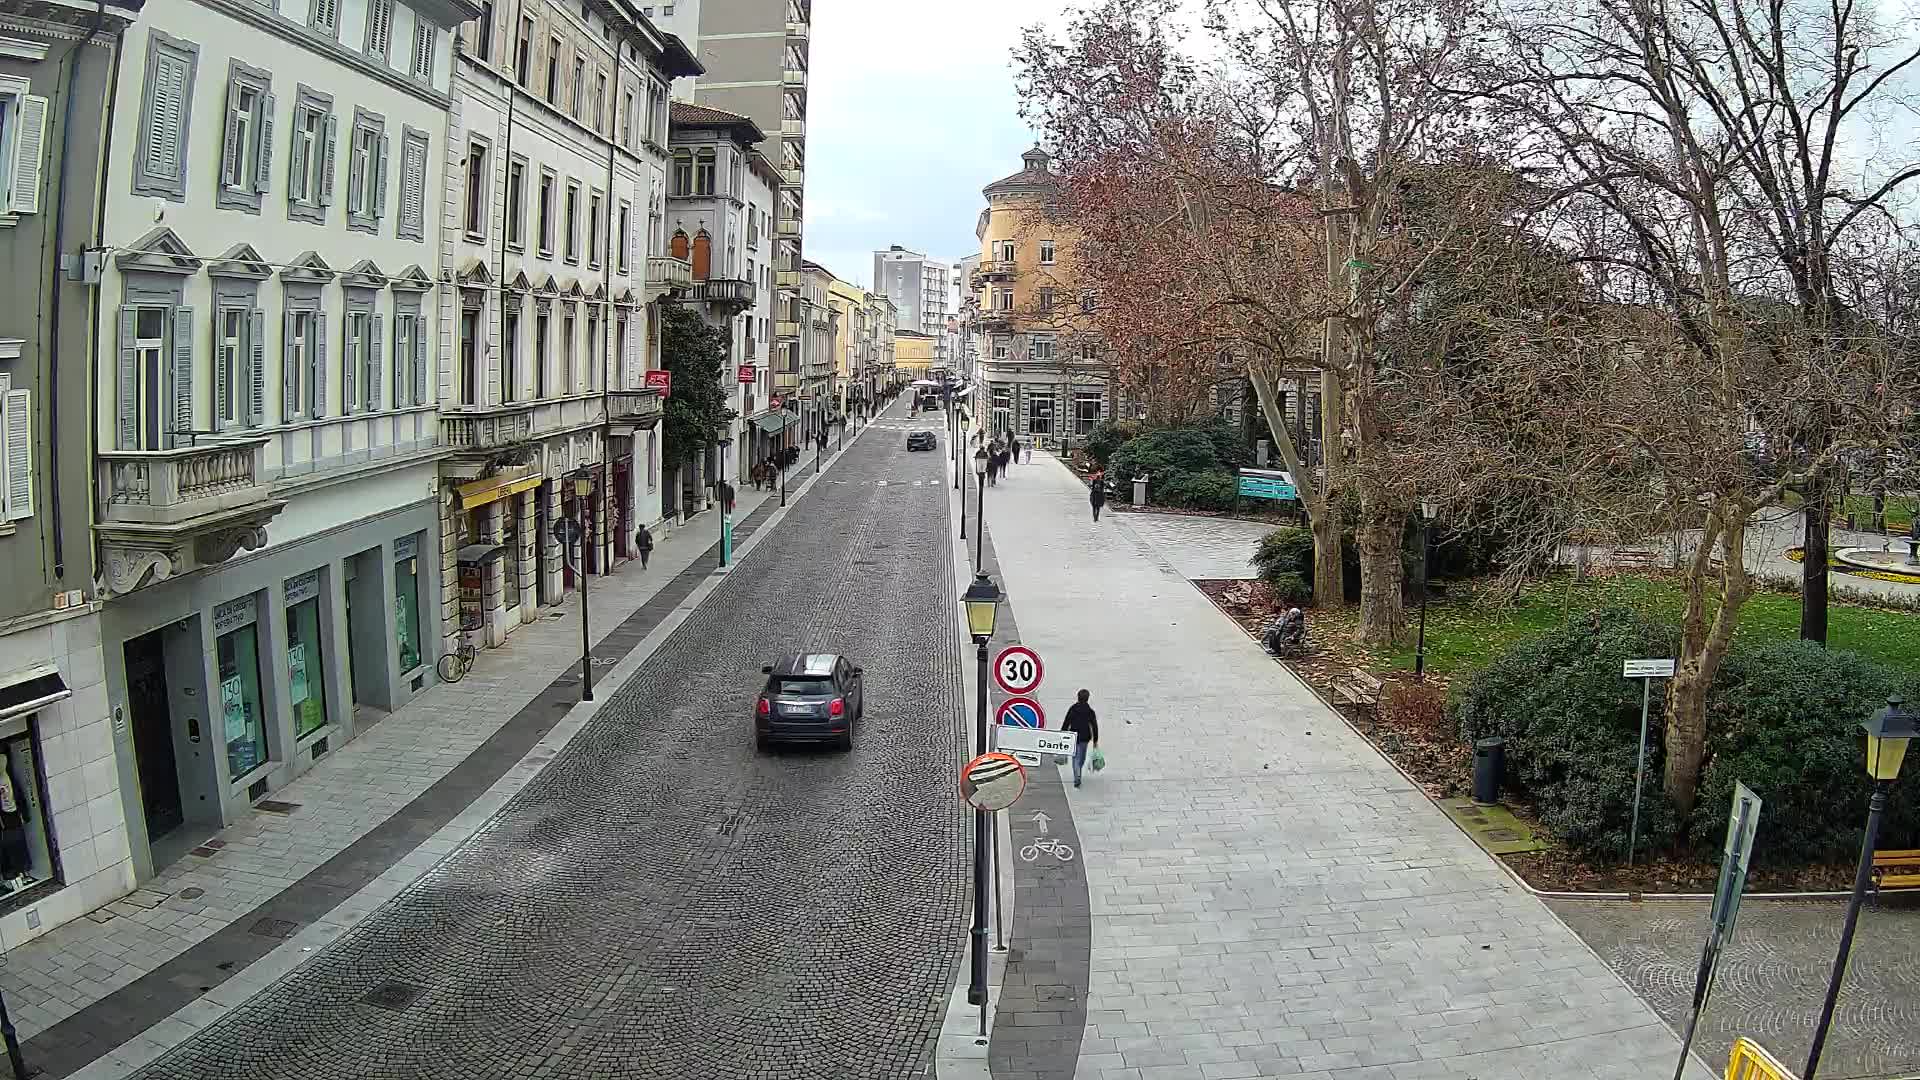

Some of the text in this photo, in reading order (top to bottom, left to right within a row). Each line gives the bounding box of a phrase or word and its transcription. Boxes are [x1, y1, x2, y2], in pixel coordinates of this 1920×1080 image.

[1005, 659, 1033, 682] 30
[222, 679, 240, 702] 130
[1038, 739, 1070, 751] Dante
